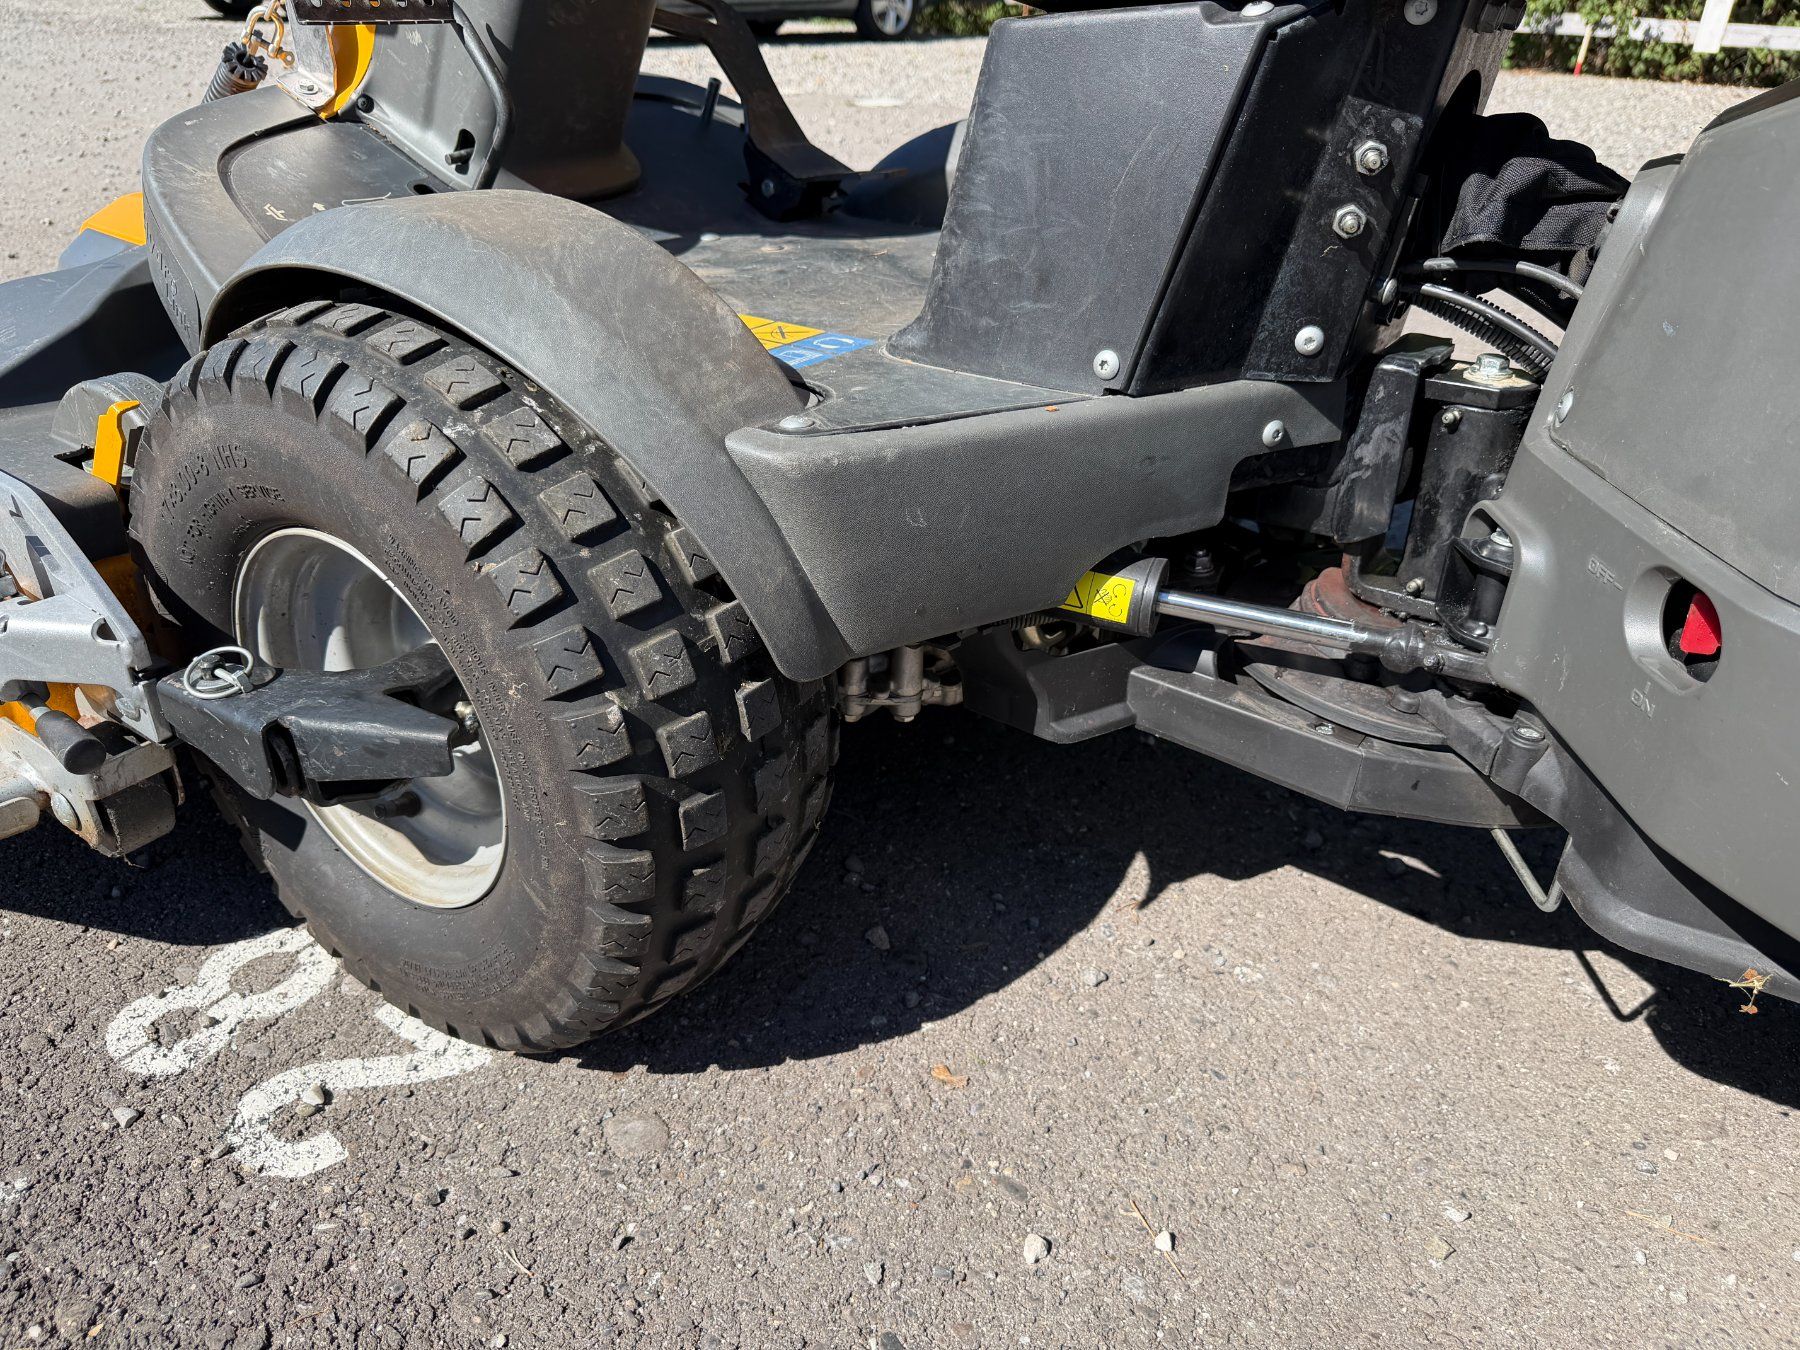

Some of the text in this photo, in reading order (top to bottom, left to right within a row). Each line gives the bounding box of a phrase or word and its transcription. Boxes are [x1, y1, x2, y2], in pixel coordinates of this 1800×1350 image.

[236, 484, 286, 504] SERVICE
[1587, 556, 1616, 584] OFF
[1631, 687, 1656, 719] ON
